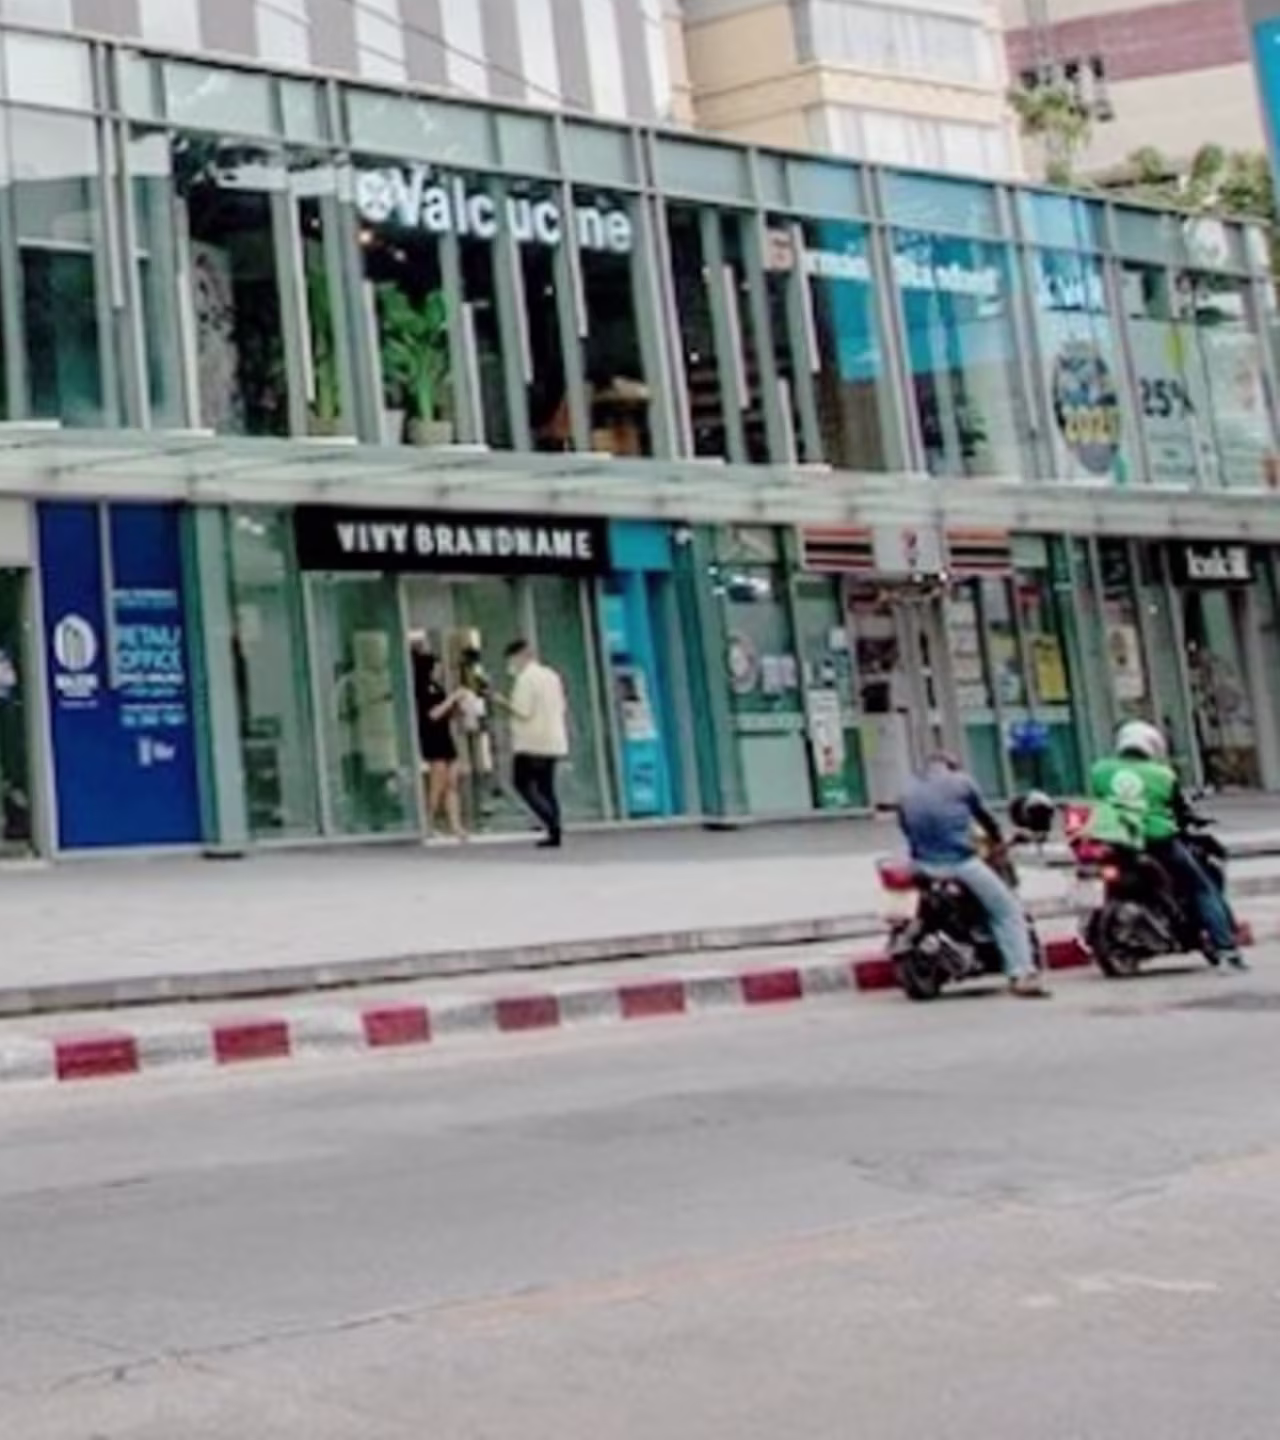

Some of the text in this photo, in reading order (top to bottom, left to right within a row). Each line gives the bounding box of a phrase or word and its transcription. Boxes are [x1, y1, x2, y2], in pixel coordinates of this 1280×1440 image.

[390, 164, 633, 253] Valcucne
[337, 521, 593, 560] VIVY BRANDNAME
